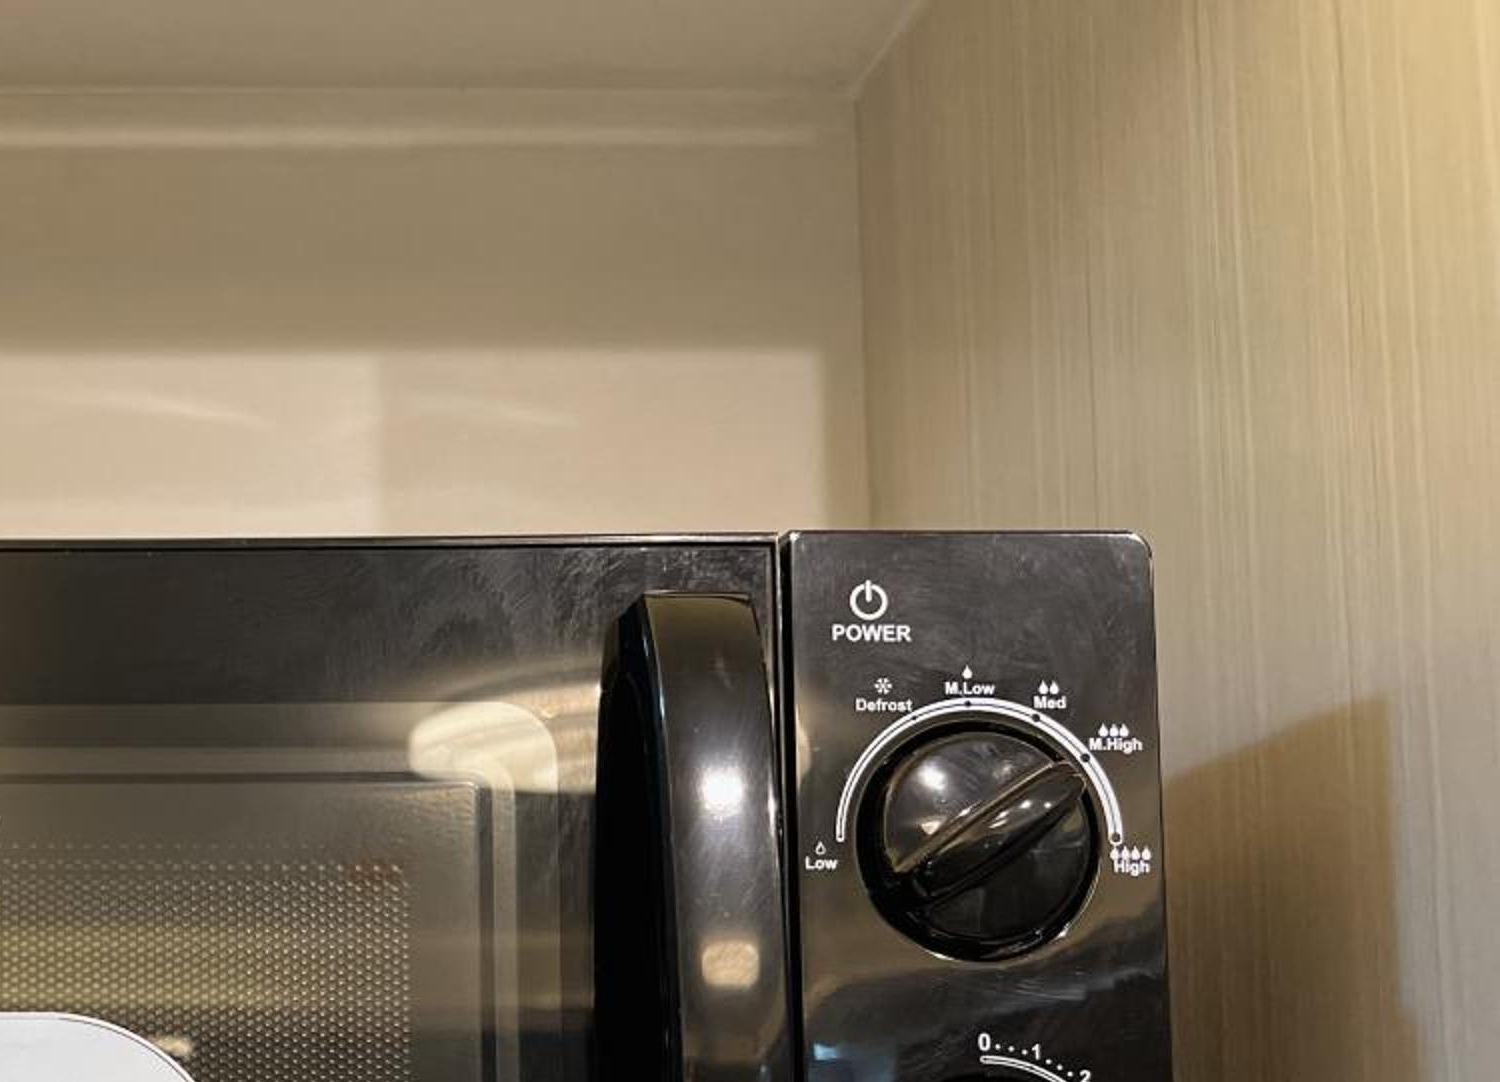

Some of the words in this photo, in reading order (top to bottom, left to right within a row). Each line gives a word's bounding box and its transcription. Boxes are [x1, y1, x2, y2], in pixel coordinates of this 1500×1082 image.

[832, 624, 912, 643] POWER
[945, 681, 995, 695] M.Low
[856, 698, 912, 712] Defrost
[1034, 696, 1067, 709] Med
[1090, 738, 1143, 755] M.High
[805, 857, 838, 870] Low
[1114, 860, 1151, 876] High
[978, 1034, 991, 1050] 0
[1032, 1045, 1041, 1060] 1
